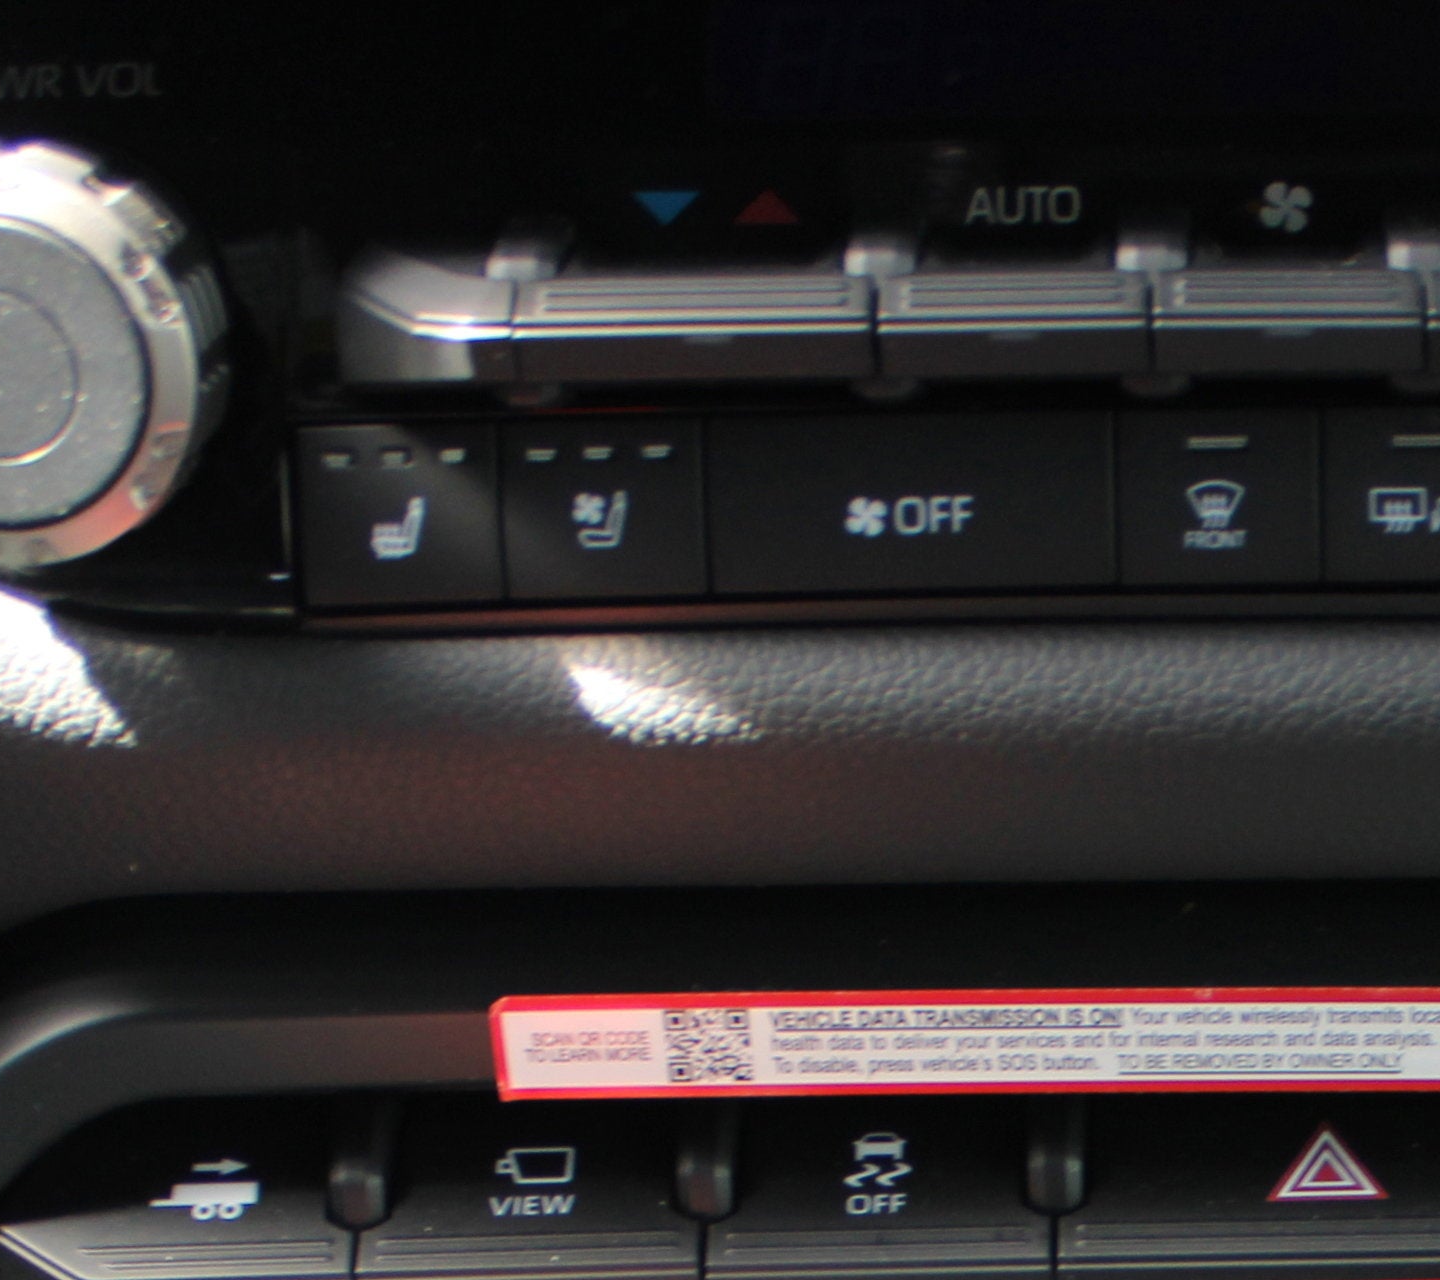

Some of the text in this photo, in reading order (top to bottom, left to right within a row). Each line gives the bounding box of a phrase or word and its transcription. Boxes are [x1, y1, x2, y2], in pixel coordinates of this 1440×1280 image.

[75, 64, 162, 100] VOL
[965, 186, 1080, 227] AUTO
[894, 496, 974, 535] OFF
[1185, 530, 1247, 549] FRONT
[772, 1008, 852, 1028] VEHICLE
[858, 1008, 907, 1027] DATA
[912, 1007, 1060, 1026] TRANSMISSION
[1066, 1007, 1085, 1025] IS
[1132, 1008, 1169, 1025] Your
[1176, 1008, 1233, 1024] vehicle
[1241, 1008, 1320, 1027] wirelessly
[1327, 1007, 1404, 1024] transmits
[605, 1030, 650, 1046] CODE
[772, 1035, 820, 1051] health
[828, 1035, 864, 1051] data
[870, 1035, 887, 1050] to
[893, 1033, 950, 1050] deliver
[956, 1035, 990, 1053] your
[997, 1032, 1066, 1049] services
[1073, 1031, 1103, 1048] and
[1110, 1031, 1130, 1048] for
[1138, 1031, 1197, 1047] internal
[1205, 1030, 1277, 1047] research
[1285, 1030, 1315, 1047] and
[1322, 1030, 1357, 1046] data
[551, 1046, 653, 1063] LEARN MORE
[772, 1055, 793, 1074] To
[868, 1057, 915, 1077] press
[998, 1053, 1036, 1071] SOS
[1117, 1052, 1139, 1069] TO
[1144, 1052, 1168, 1069] BE
[1173, 1052, 1257, 1069] REMOVED
[1263, 1052, 1283, 1068] BY
[1291, 1052, 1351, 1068] OWNER
[1359, 1051, 1405, 1068] ONLY
[489, 1195, 574, 1217] VIEW
[846, 1194, 906, 1216] OFF
